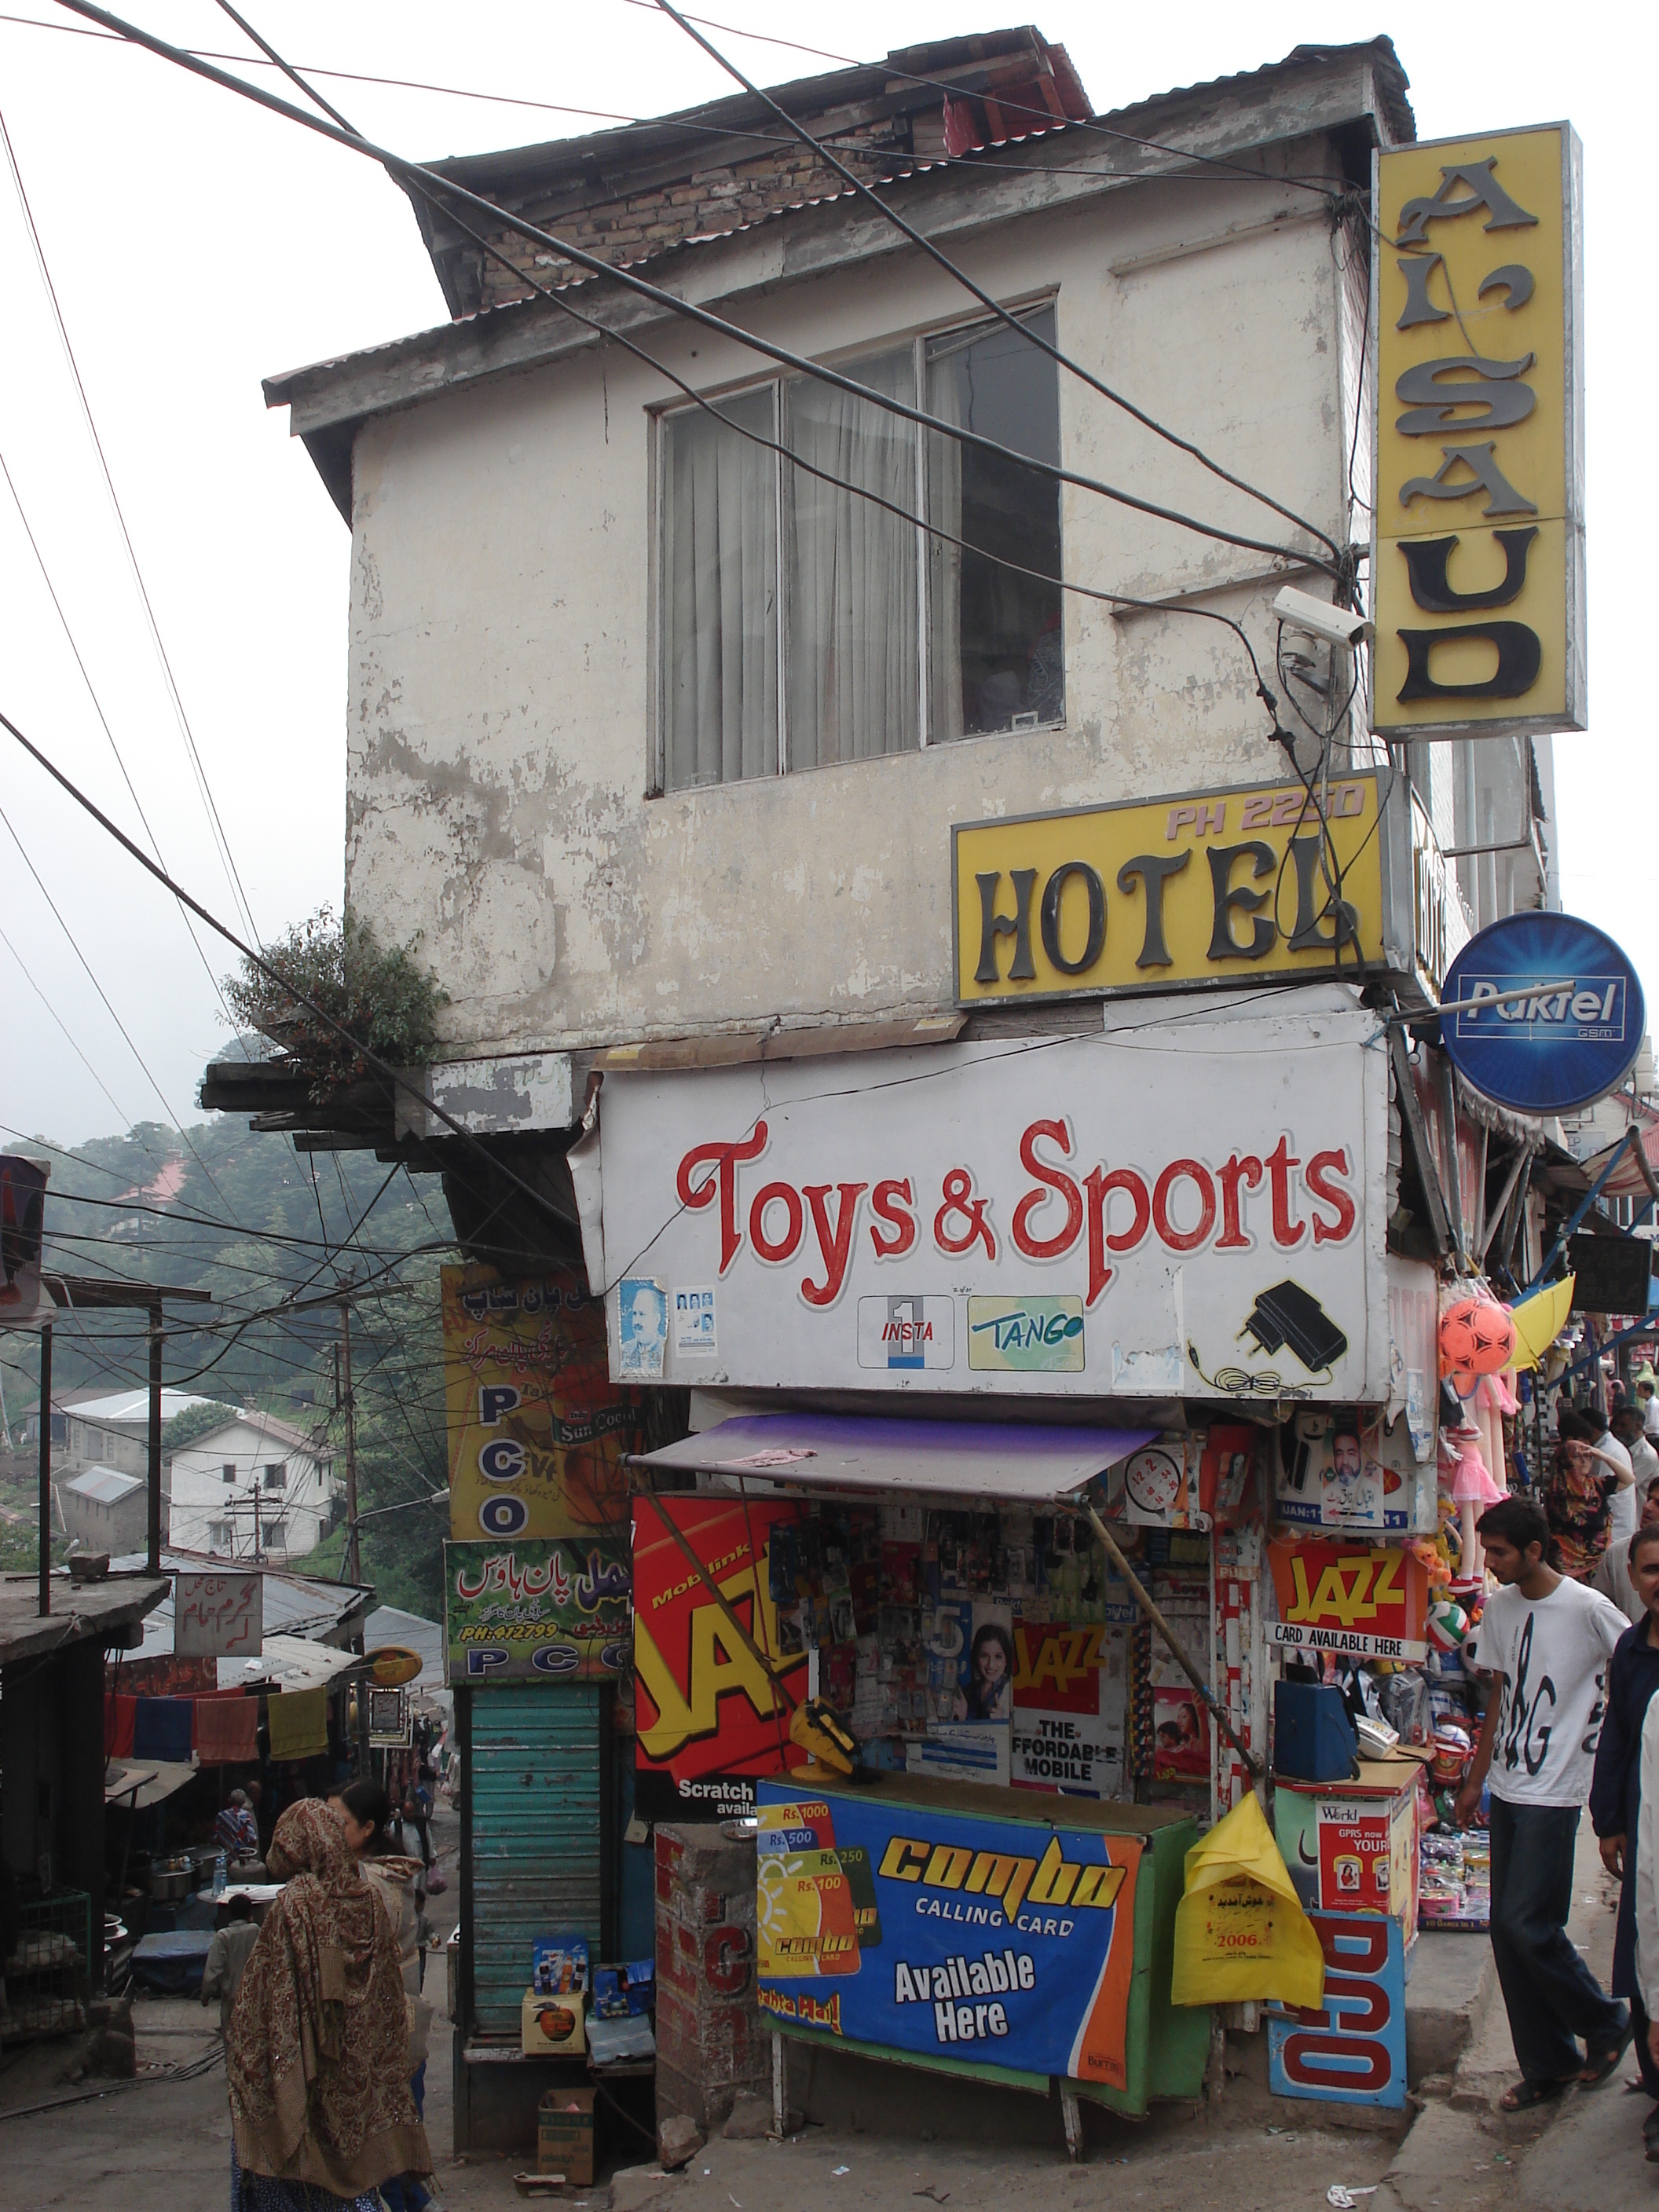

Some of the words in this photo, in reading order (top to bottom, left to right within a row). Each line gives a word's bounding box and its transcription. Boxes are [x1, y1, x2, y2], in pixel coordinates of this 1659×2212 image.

[1167, 801, 1226, 840] PH
[1241, 784, 1365, 830] 2250
[973, 833, 1360, 982] HOTEL
[1467, 980, 1617, 1024] Paktel
[1577, 1028, 1613, 1038] GSM
[676, 1119, 917, 1306] Toys
[933, 1167, 997, 1262] &
[1010, 1119, 1357, 1306] Sports
[881, 1321, 934, 1341] INSTA
[970, 1310, 1084, 1351] TANGO
[561, 1425, 593, 1442] Sun
[523, 1551, 569, 1605] پان
[651, 1543, 752, 1610] Moblink
[1287, 1547, 1406, 1626] JAZZ
[460, 1621, 559, 1642] PH:412799
[1275, 1624, 1304, 1644] CARD
[1308, 1628, 1368, 1653] AVAILABLE
[1374, 1637, 1403, 1657] HERE
[634, 1540, 811, 1758] JAZ
[1012, 1623, 1108, 1694] JAZZ
[1038, 1719, 1075, 1740] THE
[1024, 1756, 1092, 1782] MOBILE
[679, 1778, 754, 1802] Scratch
[800, 1804, 830, 1820] 1000
[1321, 1806, 1357, 1821] World
[788, 1830, 812, 1844] 500
[1339, 1829, 1363, 1839] GPRS
[1364, 1830, 1383, 1839] now
[1353, 1839, 1388, 1852] YOUR
[820, 1852, 837, 1866] Rs.
[840, 1849, 863, 1864] 250
[797, 1880, 815, 1892] Rs.
[817, 1876, 841, 1891] 100
[877, 1835, 1128, 1926] combo
[914, 1896, 1003, 1928] CALLING
[1016, 1914, 1075, 1938] CARD
[775, 1928, 855, 1962] combo
[1217, 1934, 1258, 1947] 2006
[786, 1954, 814, 1963] CALLING
[894, 1950, 1035, 2005] Available
[797, 1990, 844, 2037] Hai!
[933, 1999, 1009, 2043] Here
